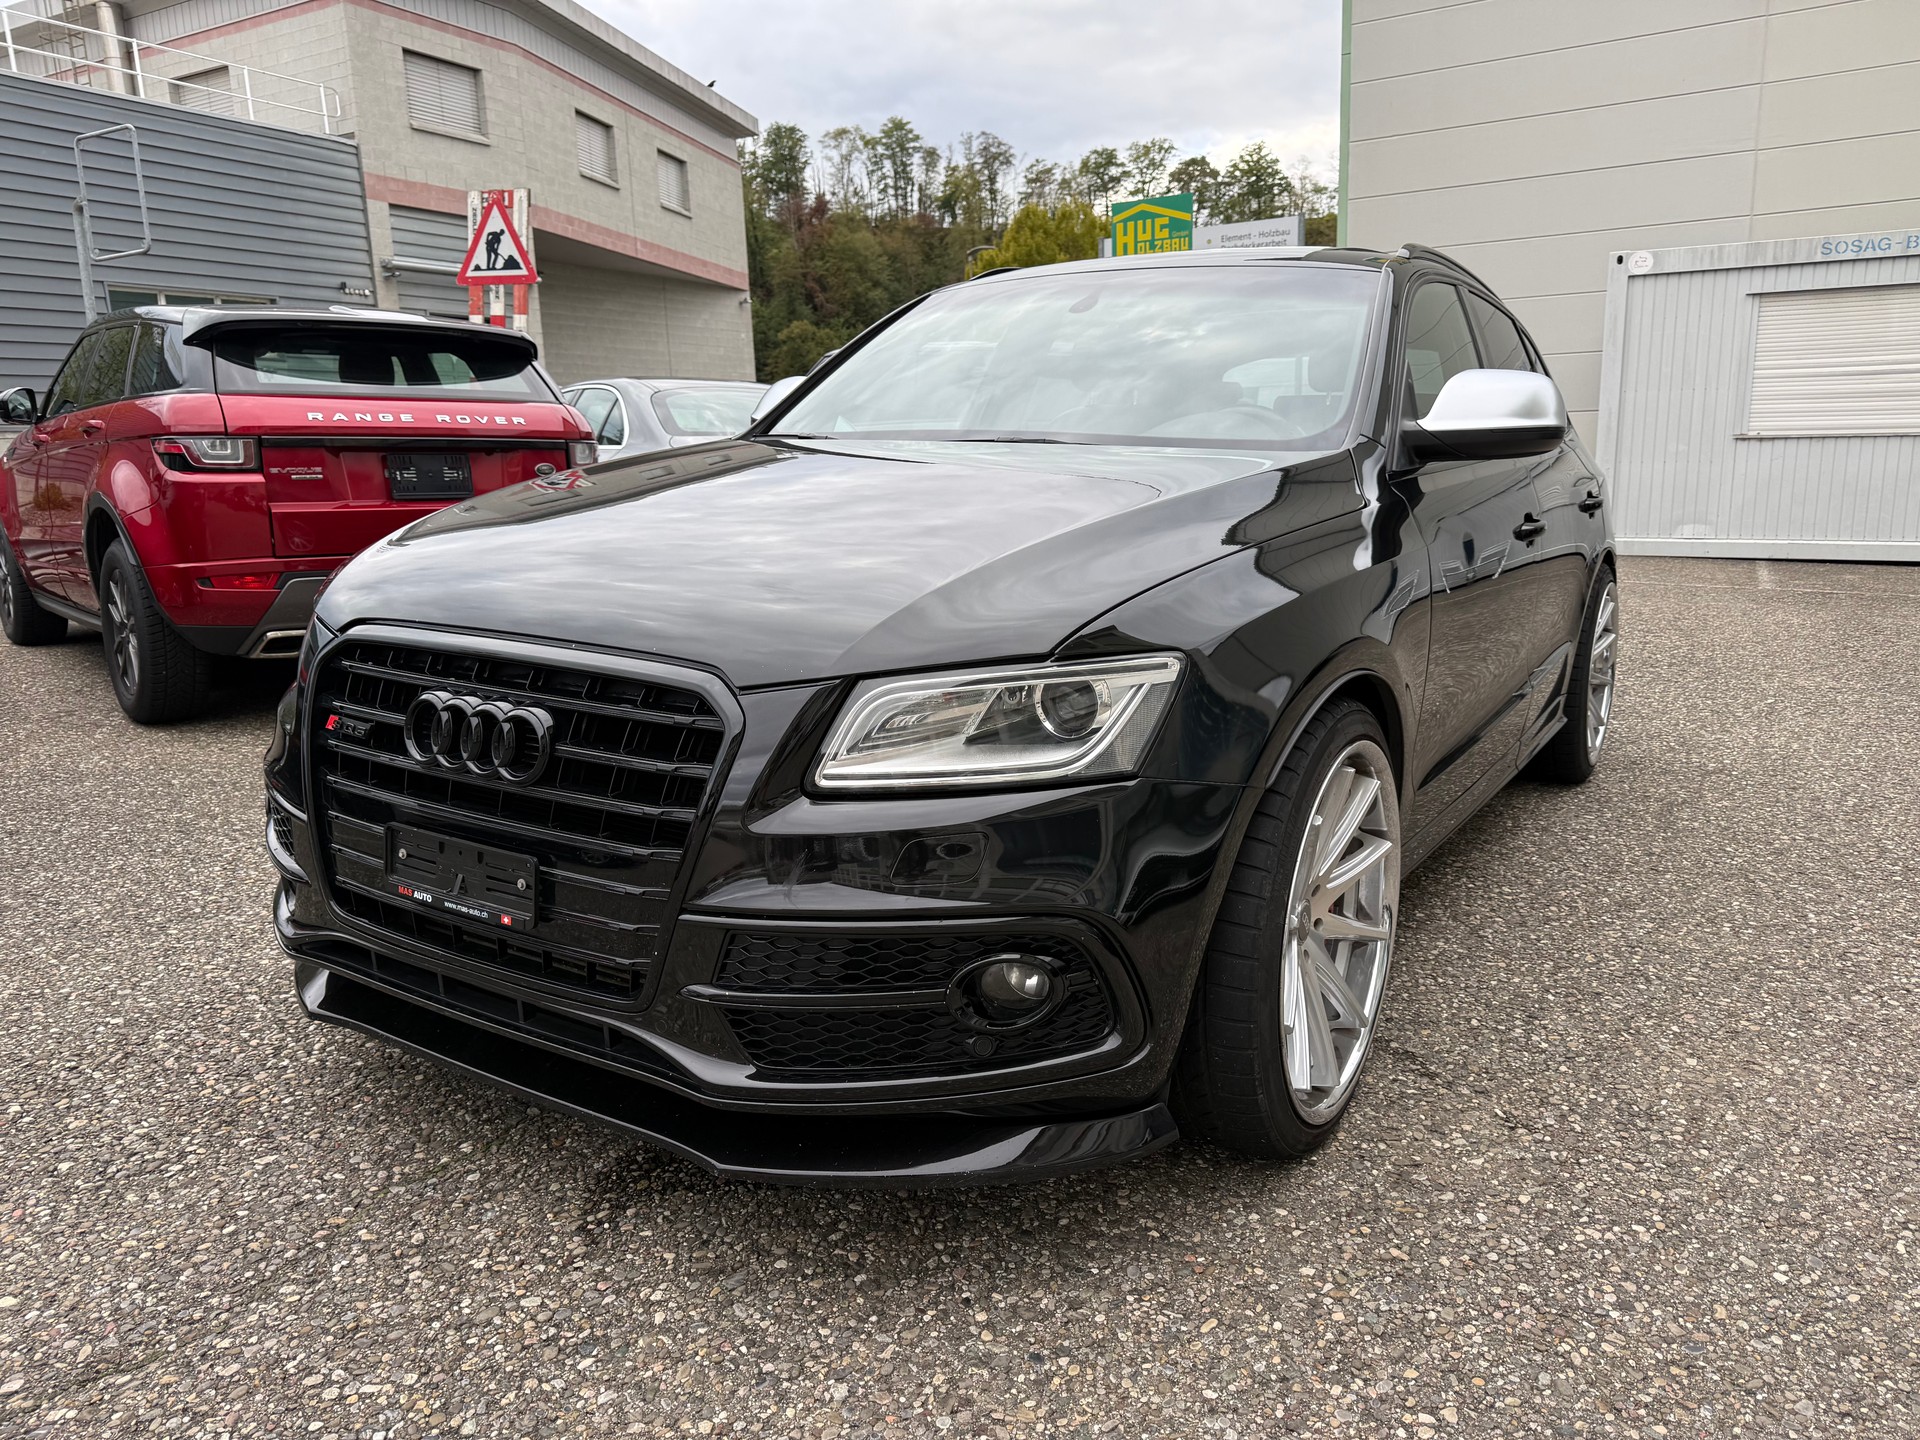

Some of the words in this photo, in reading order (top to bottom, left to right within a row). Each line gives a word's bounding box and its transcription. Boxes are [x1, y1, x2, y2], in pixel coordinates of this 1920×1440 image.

[1116, 217, 1169, 256] HUG
[1220, 233, 1252, 243] Element
[1258, 228, 1291, 239] Holzbau
[307, 412, 414, 422] RANGE
[435, 414, 527, 425] ROVER
[398, 885, 413, 897] MAS
[413, 890, 432, 903] AUTO
[444, 901, 489, 919] www.mas-auto.ch
